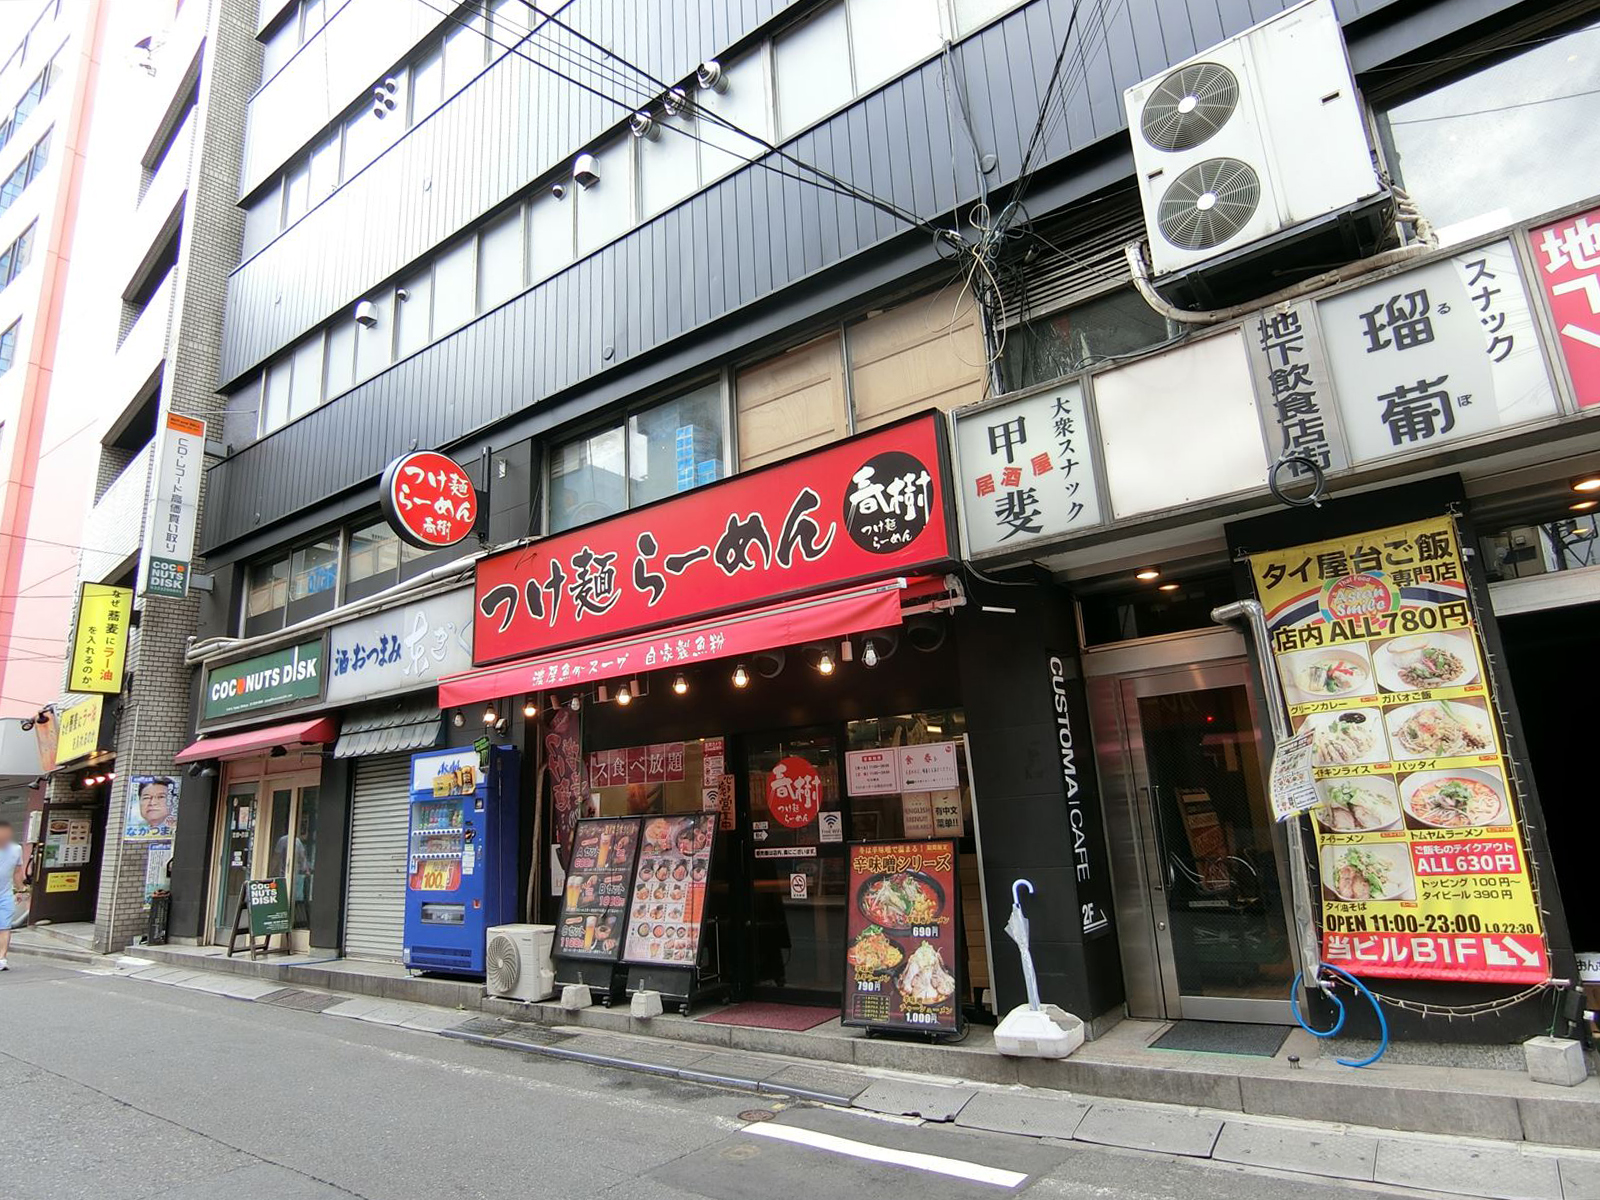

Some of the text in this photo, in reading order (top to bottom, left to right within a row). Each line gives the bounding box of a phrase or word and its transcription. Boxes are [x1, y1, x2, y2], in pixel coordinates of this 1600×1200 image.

[1437, 302, 1451, 315] る
[1465, 258, 1514, 363] スナック
[1257, 310, 1331, 478] 地下飲食店街
[1051, 397, 1084, 523] 大衆スナック
[404, 466, 470, 498] つけ麺
[975, 452, 1054, 498] 居酒屋
[988, 416, 1044, 542] 甲斐
[399, 484, 475, 523] らーめん
[860, 518, 897, 535] つけ麺
[872, 529, 913, 549] らーめん
[480, 487, 836, 634] つけ麺 らーめん
[1262, 530, 1454, 590] タイ屋台ご飯
[150, 576, 183, 589] DISK
[151, 568, 184, 581] NUTS
[1390, 561, 1458, 588] 専門店
[1334, 586, 1385, 605] Asian
[1337, 598, 1386, 616] Smile
[1274, 602, 1469, 652] 店内 ALL 780円
[211, 645, 318, 701] COCONUTS DISK
[1290, 701, 1349, 715] グリーンカレー
[1410, 828, 1484, 841] トムヤムラーメン
[1414, 842, 1514, 855] ご飯ものテイクアウト
[853, 853, 952, 874] 辛味噌シリーズ
[1417, 854, 1516, 873] ALL 630円
[250, 882, 277, 890] COCO
[251, 888, 278, 897] NUTS
[1421, 877, 1468, 889] トッピング
[251, 895, 278, 906] DISK
[1422, 889, 1513, 900] タイビール 390円
[1082, 902, 1095, 926] 2F
[1326, 914, 1367, 932] OPEN
[1370, 913, 1481, 933] 11:00-23:00
[912, 926, 939, 938] 690円
[1326, 935, 1478, 964] 当ビルB1F
[857, 981, 881, 992] 790円
[905, 1012, 938, 1024] 1,000円
